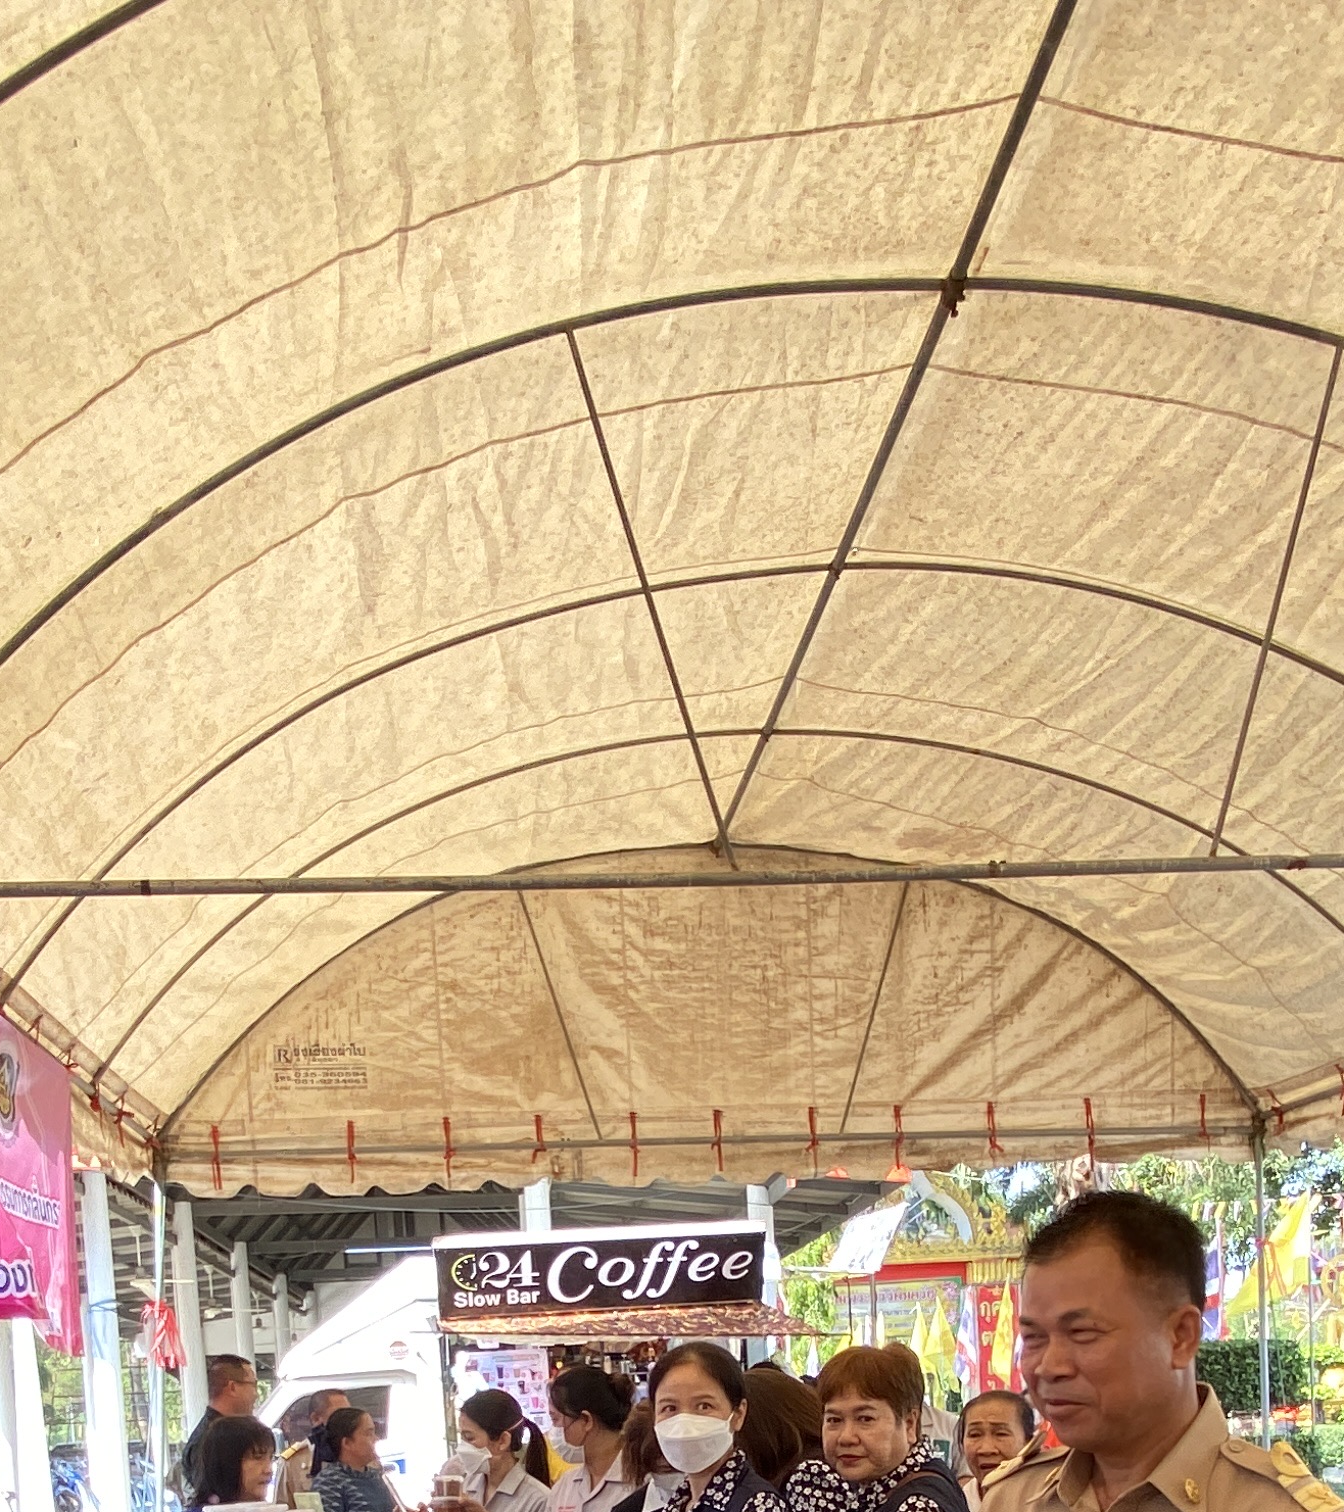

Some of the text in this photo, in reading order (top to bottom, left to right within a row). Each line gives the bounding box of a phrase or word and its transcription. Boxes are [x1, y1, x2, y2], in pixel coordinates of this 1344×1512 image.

[479, 1239, 755, 1305] 24 Coffee
[453, 1289, 541, 1309] Slow Bar
